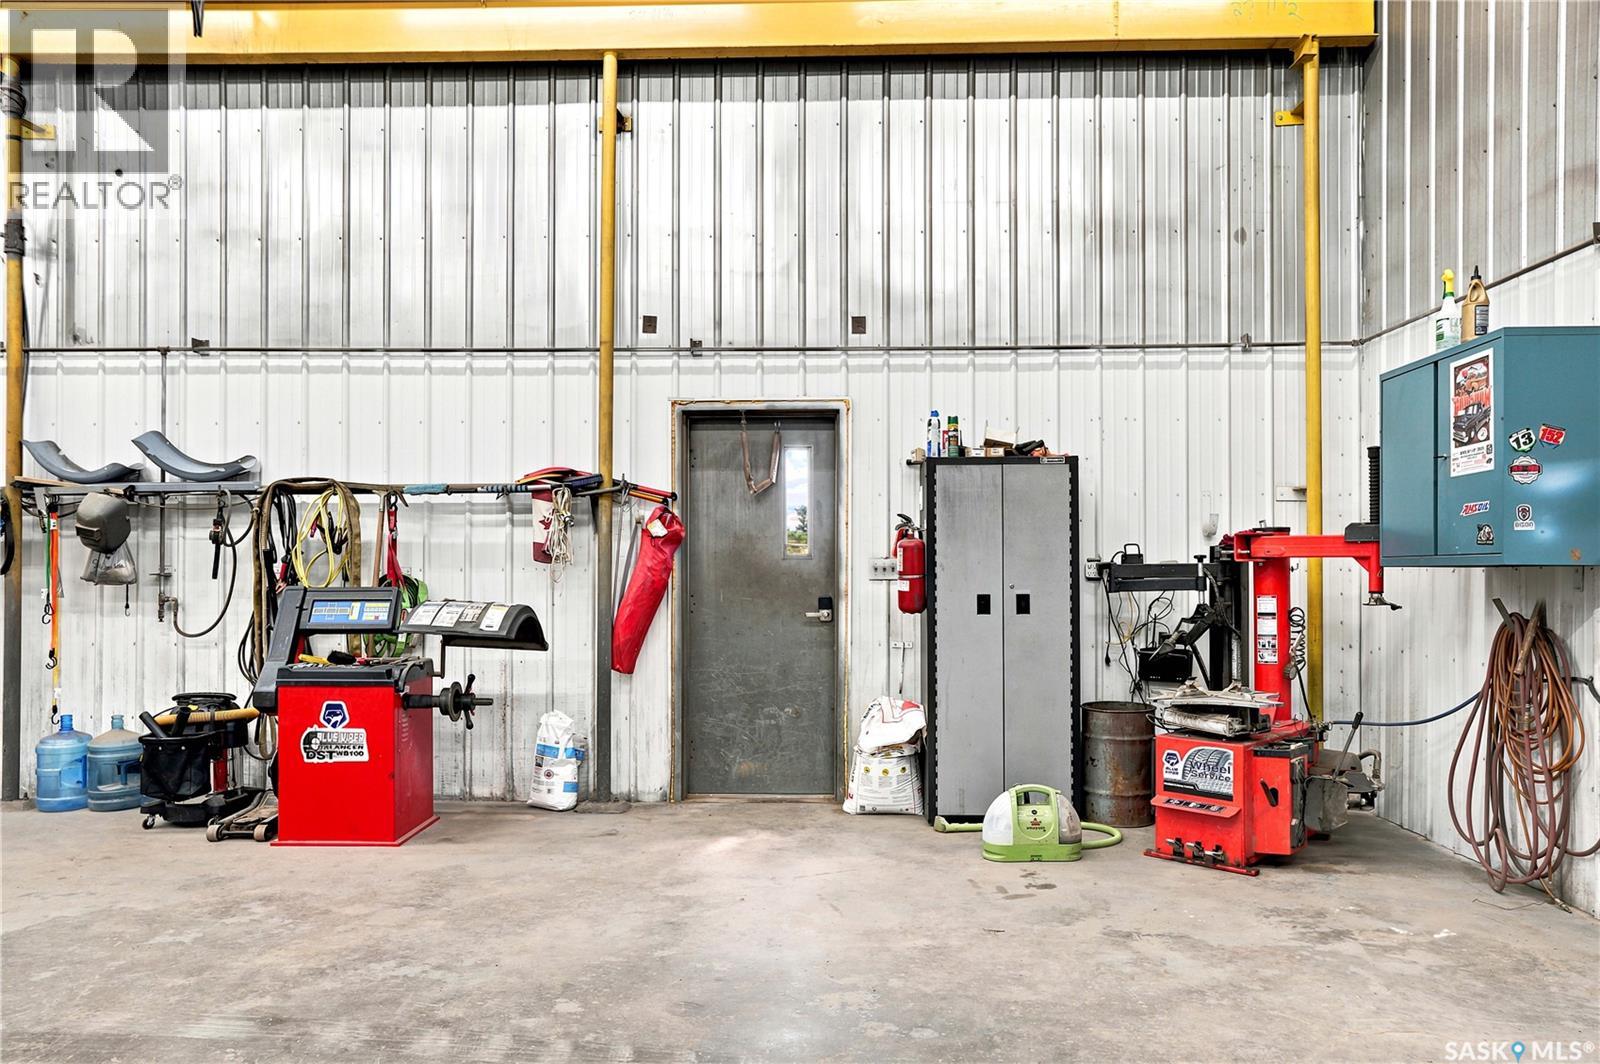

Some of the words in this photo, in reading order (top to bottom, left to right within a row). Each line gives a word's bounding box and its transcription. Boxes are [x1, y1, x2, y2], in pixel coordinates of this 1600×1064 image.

[1511, 431, 1534, 449] 13
[1541, 428, 1564, 444] 152
[1462, 502, 1488, 515] AMSOIL
[306, 750, 335, 760] DST
[1190, 760, 1231, 774] Wheel
[1190, 769, 1231, 782] Service
